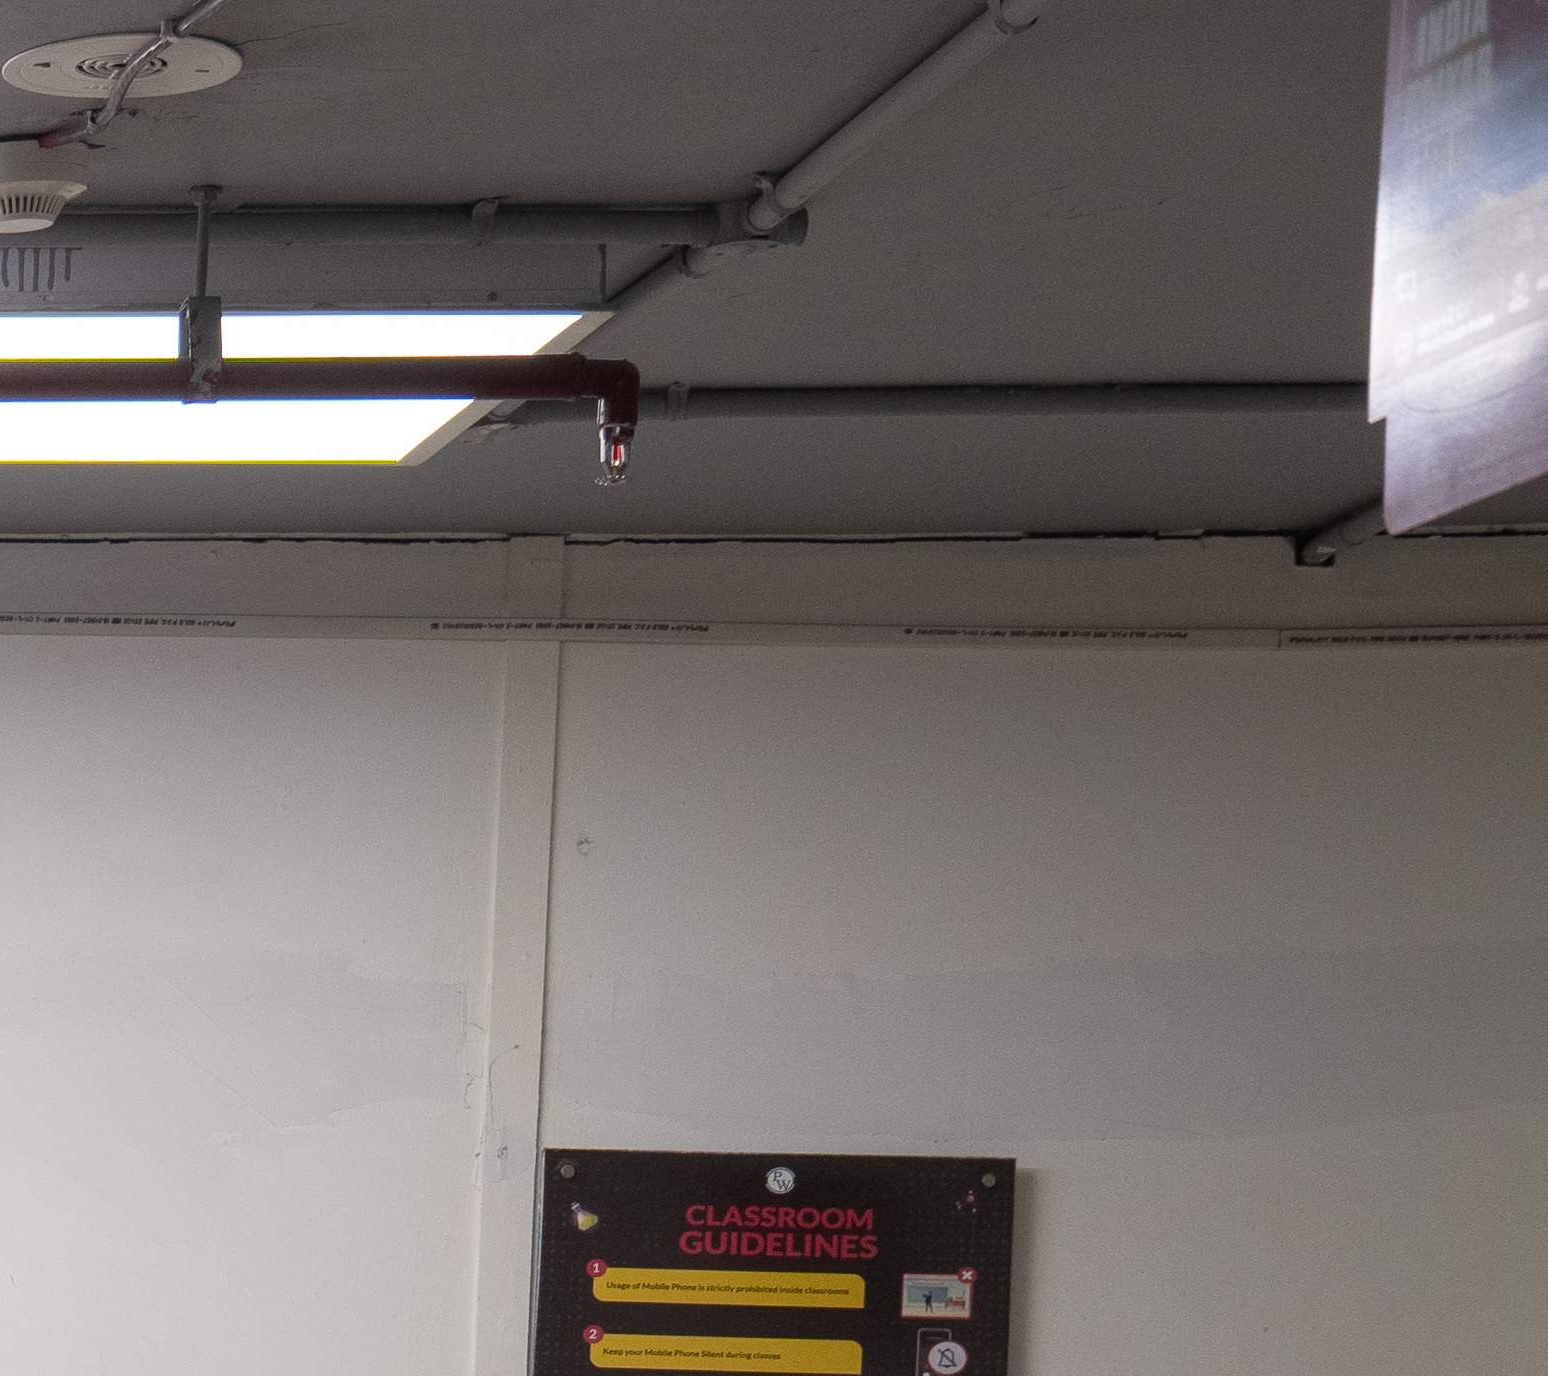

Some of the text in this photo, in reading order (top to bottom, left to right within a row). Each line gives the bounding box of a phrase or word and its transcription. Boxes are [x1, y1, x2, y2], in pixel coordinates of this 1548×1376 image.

[685, 1204, 873, 1230] CLASSROOM
[678, 1230, 877, 1259] GUIDELINES
[592, 1262, 850, 1296] 1 Usage of Mobile Phone is strictly prohibited inside classrooms
[588, 1329, 598, 1340] 2
